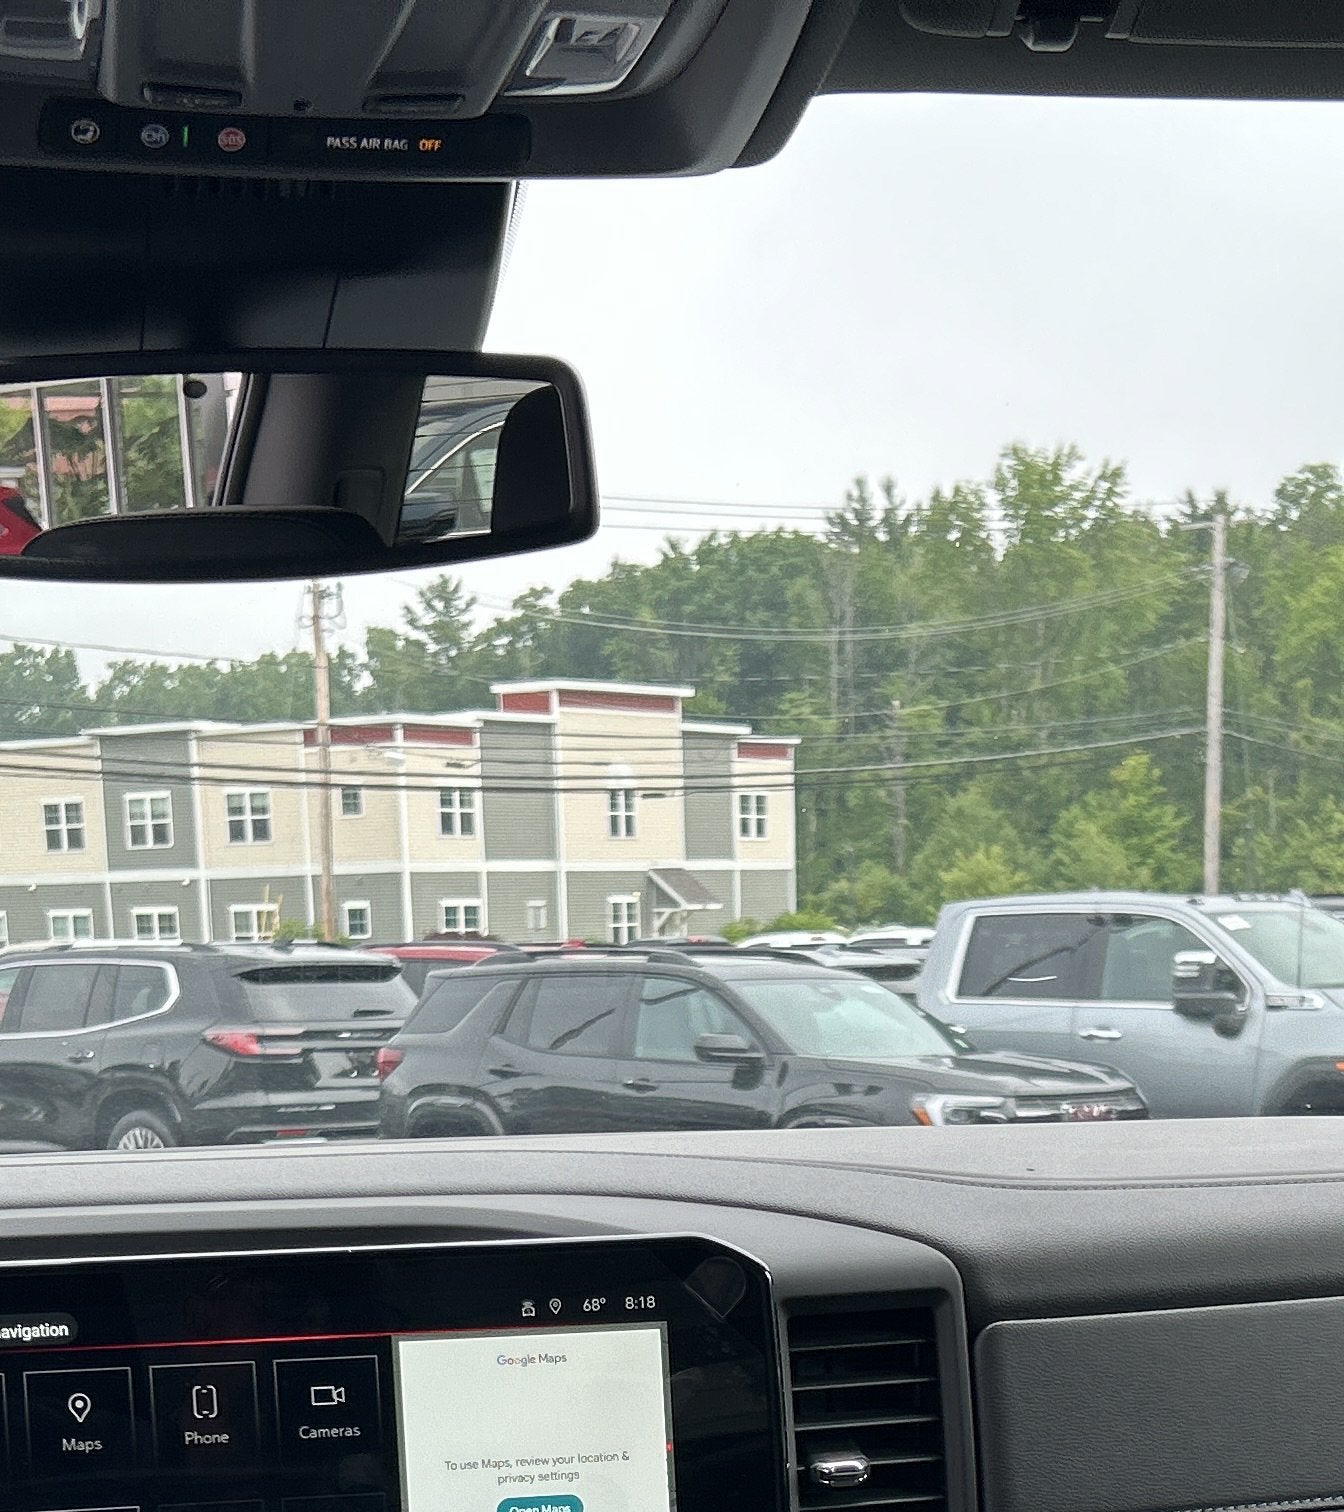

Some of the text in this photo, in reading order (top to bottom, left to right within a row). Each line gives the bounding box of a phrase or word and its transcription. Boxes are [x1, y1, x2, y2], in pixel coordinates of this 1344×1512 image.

[221, 134, 243, 146] SOS
[327, 136, 443, 152] PASS AIR BAG OFF
[625, 1296, 656, 1310] 8:18
[496, 1352, 568, 1368] Google Maps
[184, 1431, 230, 1445] Phone
[299, 1426, 361, 1440] Cameras
[62, 1438, 103, 1453] Maps
[445, 1451, 630, 1471] To use Maps, review your location &
[497, 1471, 580, 1486] privacy settings
